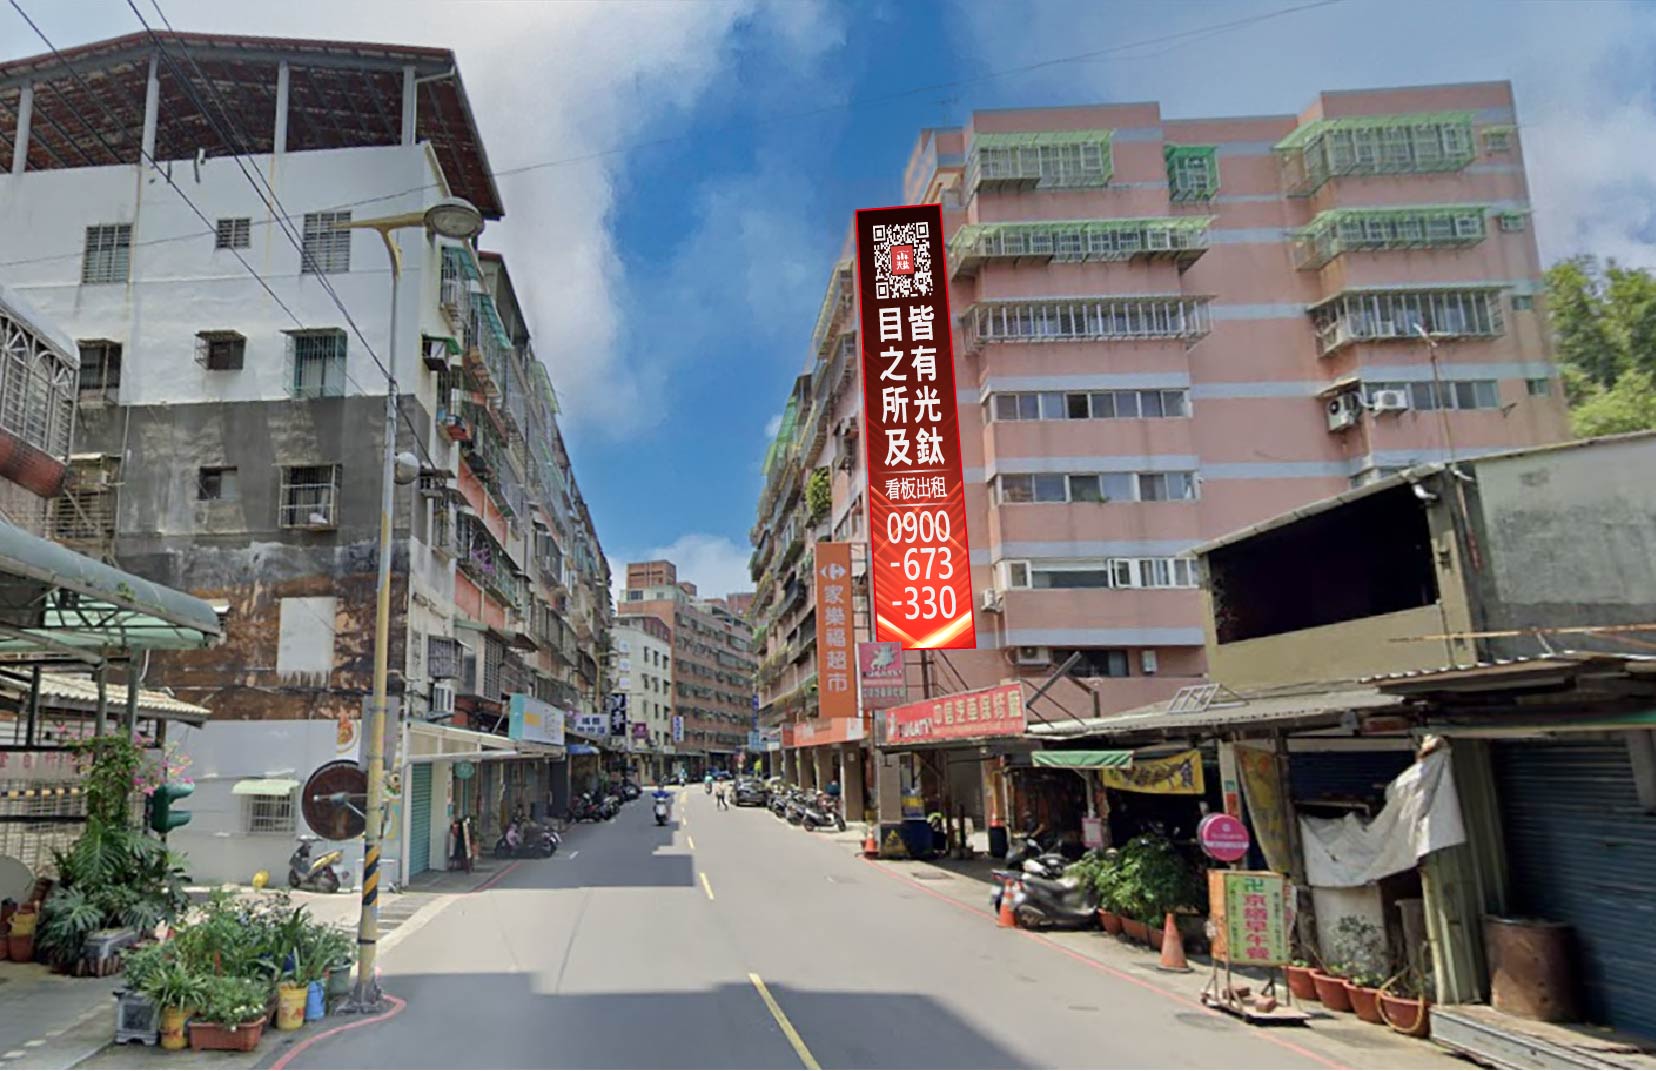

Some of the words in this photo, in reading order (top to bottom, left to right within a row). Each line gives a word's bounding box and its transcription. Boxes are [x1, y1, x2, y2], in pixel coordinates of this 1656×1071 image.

[879, 307, 912, 467] 目之所及
[908, 305, 945, 465] 皆有光鈦
[885, 476, 947, 500] 看板出租
[886, 510, 951, 544] 0900
[890, 547, 954, 581] -673
[892, 585, 957, 620] -330
[824, 584, 848, 693] 家樂福超市
